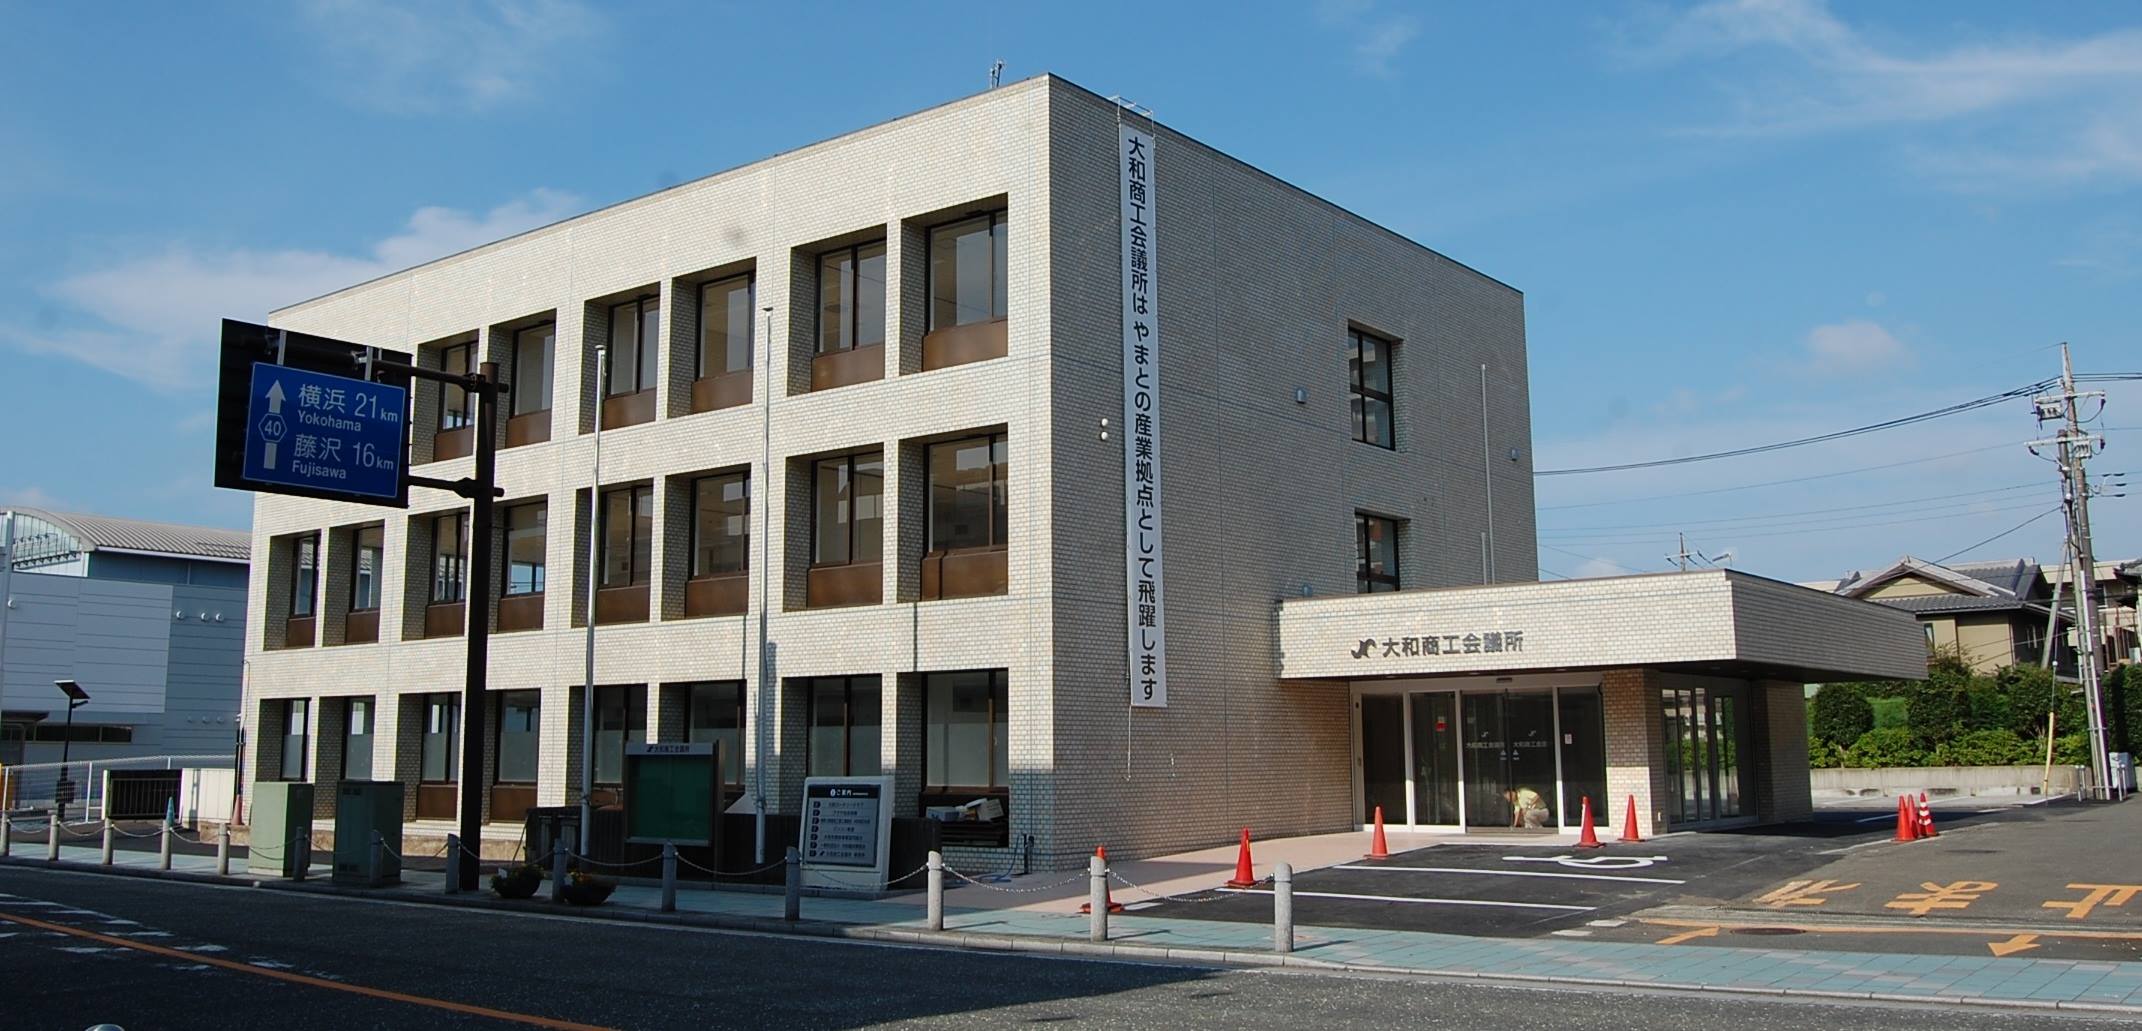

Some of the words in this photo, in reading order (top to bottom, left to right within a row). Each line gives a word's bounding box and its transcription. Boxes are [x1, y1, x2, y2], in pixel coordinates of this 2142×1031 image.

[1128, 136, 1149, 315] 大和商工会議所は
[298, 383, 346, 414] 横浜
[264, 419, 282, 436] 40
[297, 410, 362, 432] Yokohama
[294, 433, 341, 462] 藤沢
[291, 459, 347, 480] Fujisawa
[1133, 321, 1157, 700] やまとの産業拠点として飛躍します
[1382, 630, 1524, 657] 大和商工会議所
